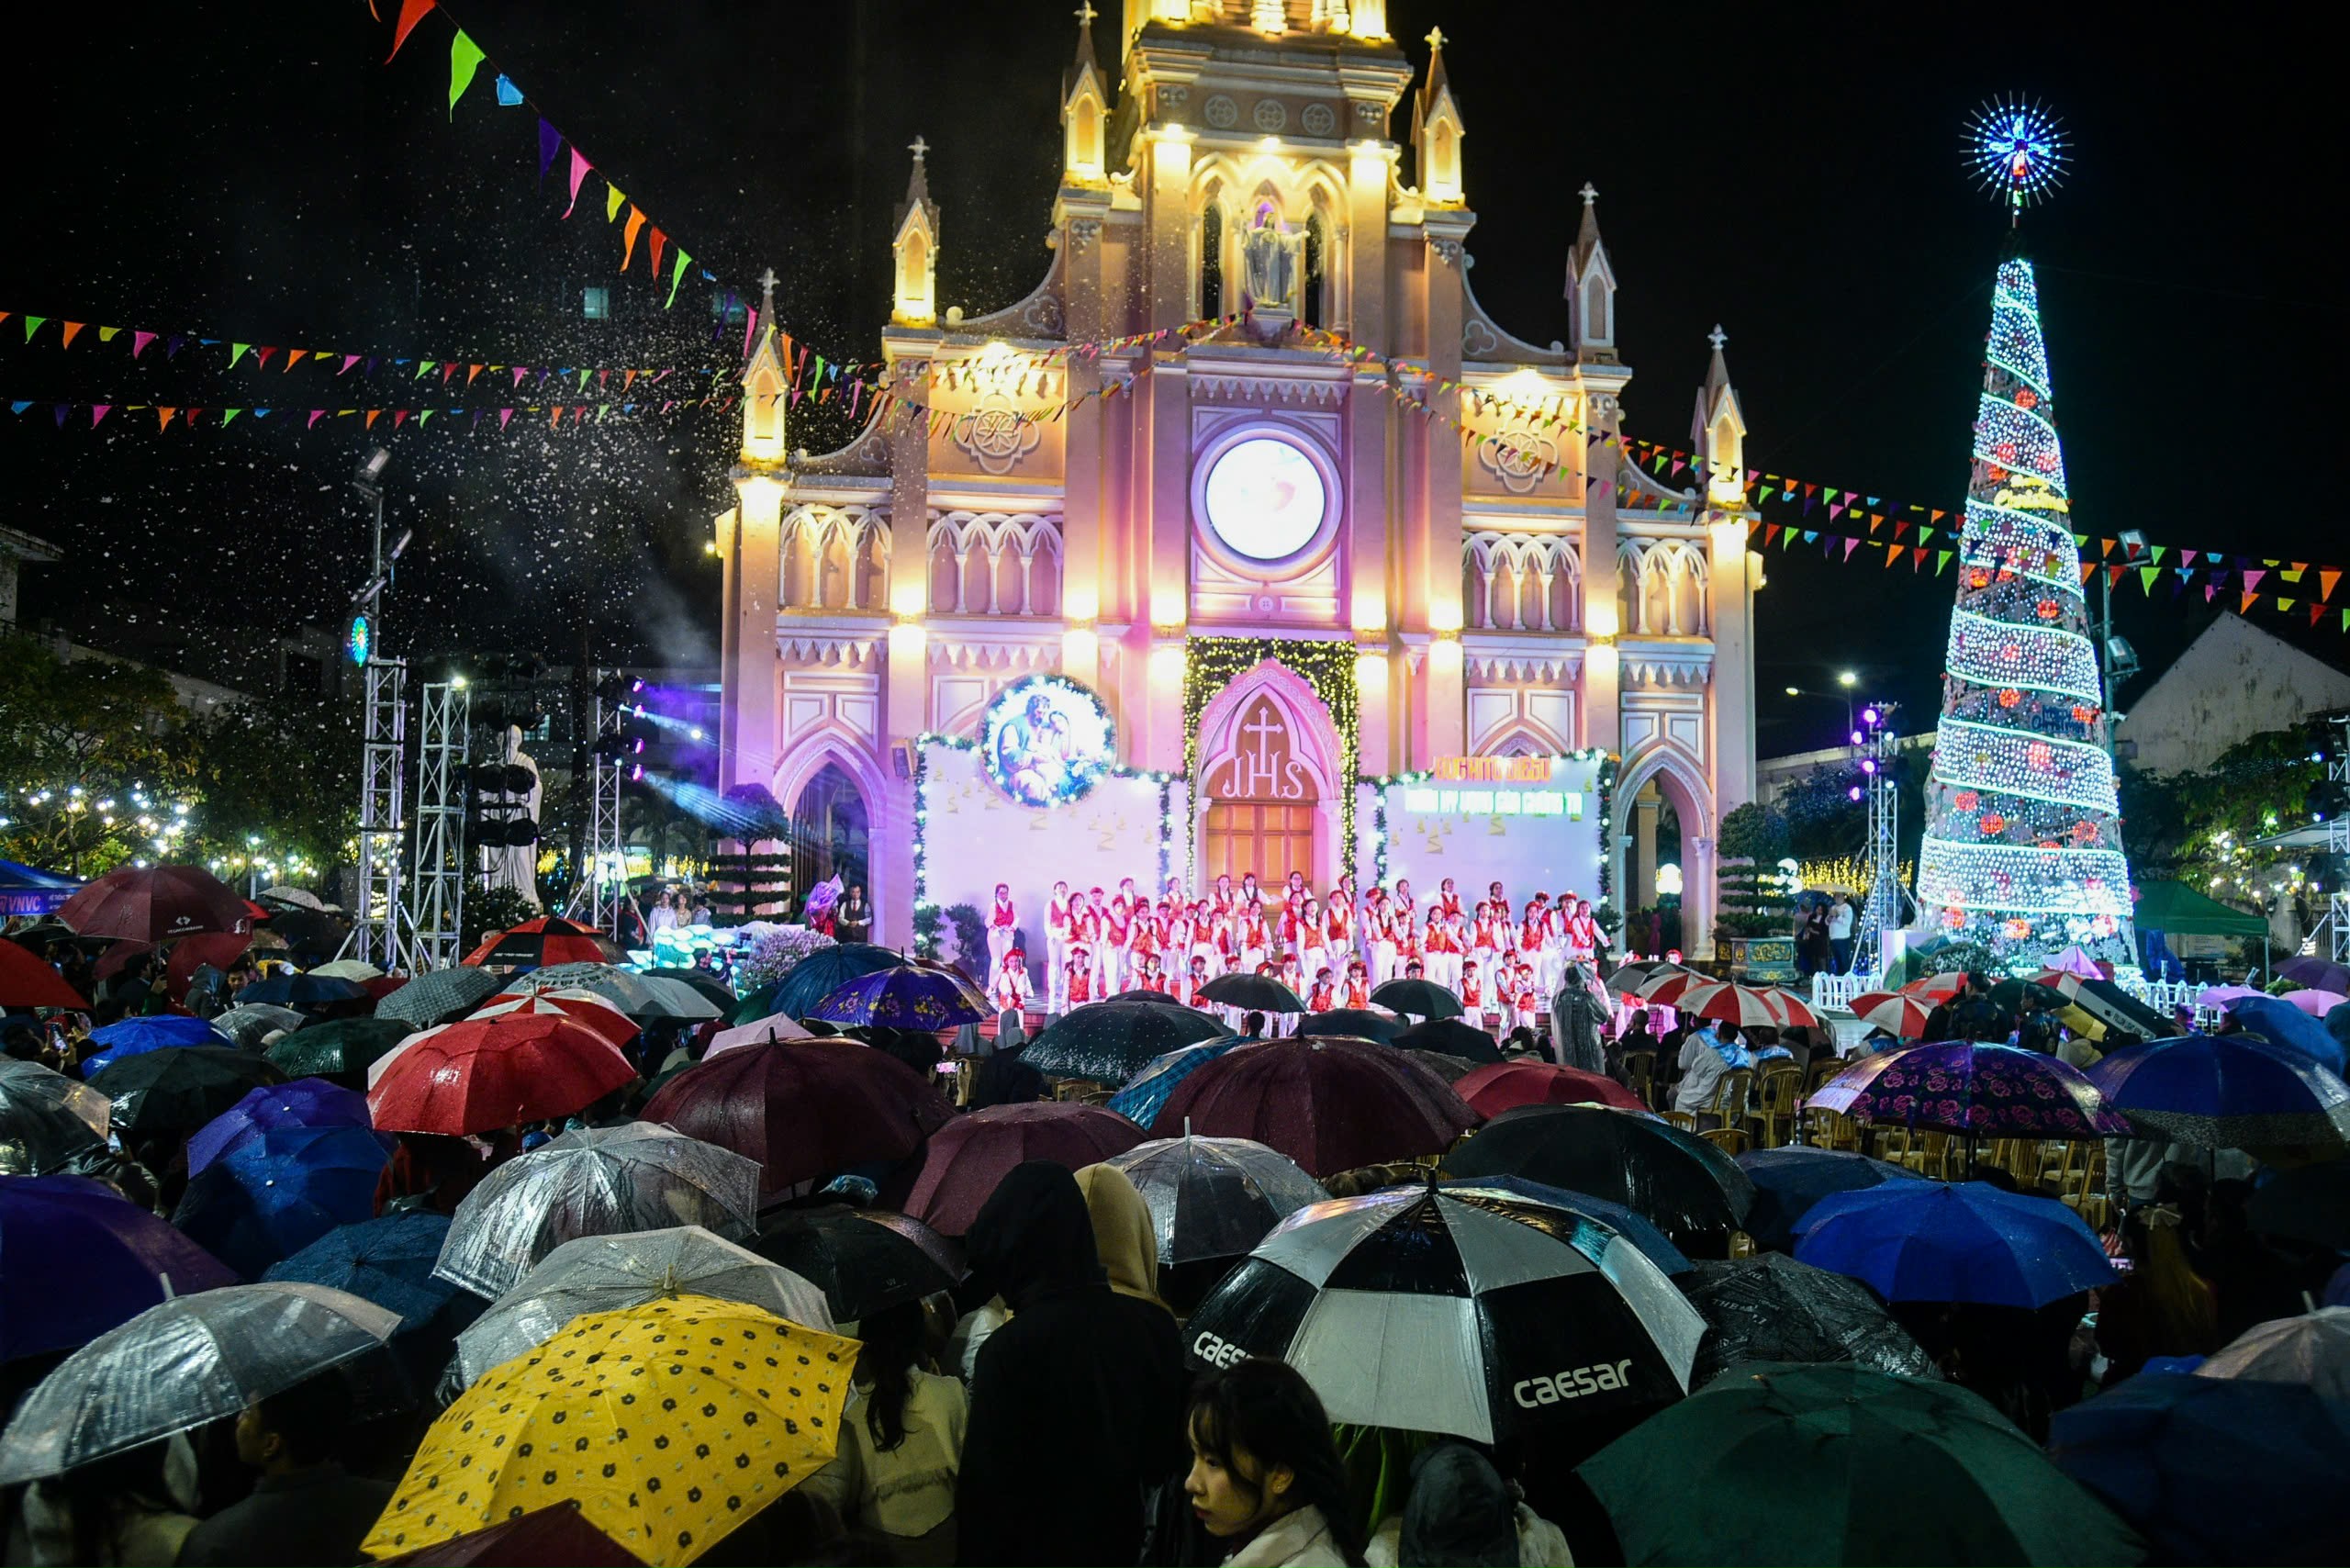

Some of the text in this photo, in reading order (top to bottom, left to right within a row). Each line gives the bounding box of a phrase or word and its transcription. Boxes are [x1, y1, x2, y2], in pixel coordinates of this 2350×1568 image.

[9, 895, 41, 912] VNVC
[1193, 1330, 1254, 1370] caes
[1514, 1359, 1632, 1408] caesar
